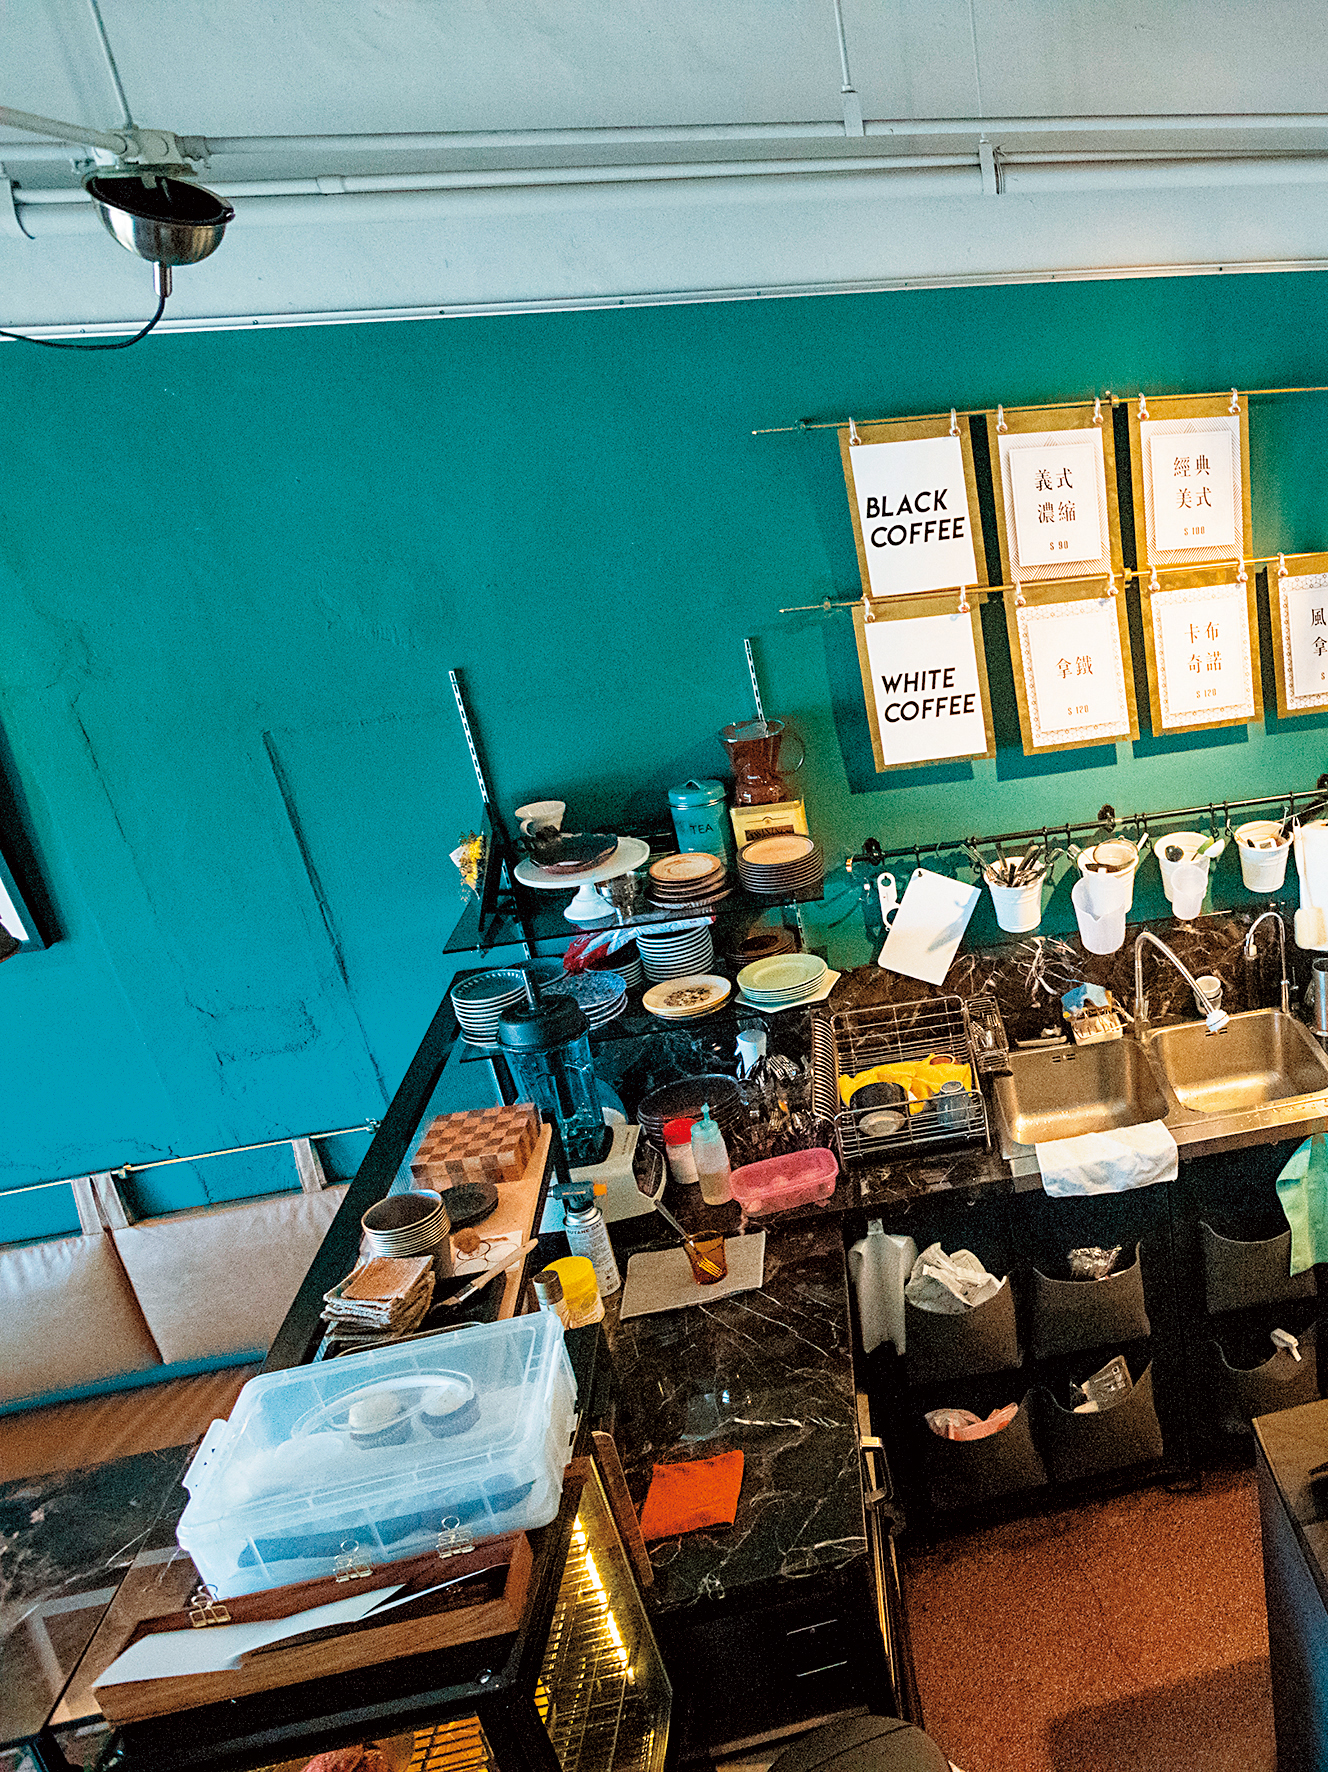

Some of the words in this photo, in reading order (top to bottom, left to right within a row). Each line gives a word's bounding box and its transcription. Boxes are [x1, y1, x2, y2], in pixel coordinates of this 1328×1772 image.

[1173, 454, 1211, 478] 經典
[1034, 467, 1073, 492] 義式
[866, 488, 948, 519] BLACK
[1175, 486, 1212, 510] 美式
[1037, 500, 1076, 524] 濃縮
[871, 516, 965, 548] COFFEE
[1184, 621, 1220, 644] 卡布
[1055, 655, 1094, 679] 拿鐵
[1187, 650, 1222, 674] 奇諾
[881, 667, 956, 695] WHITE
[884, 693, 976, 723] COFFEE
[690, 823, 714, 836] TEA
